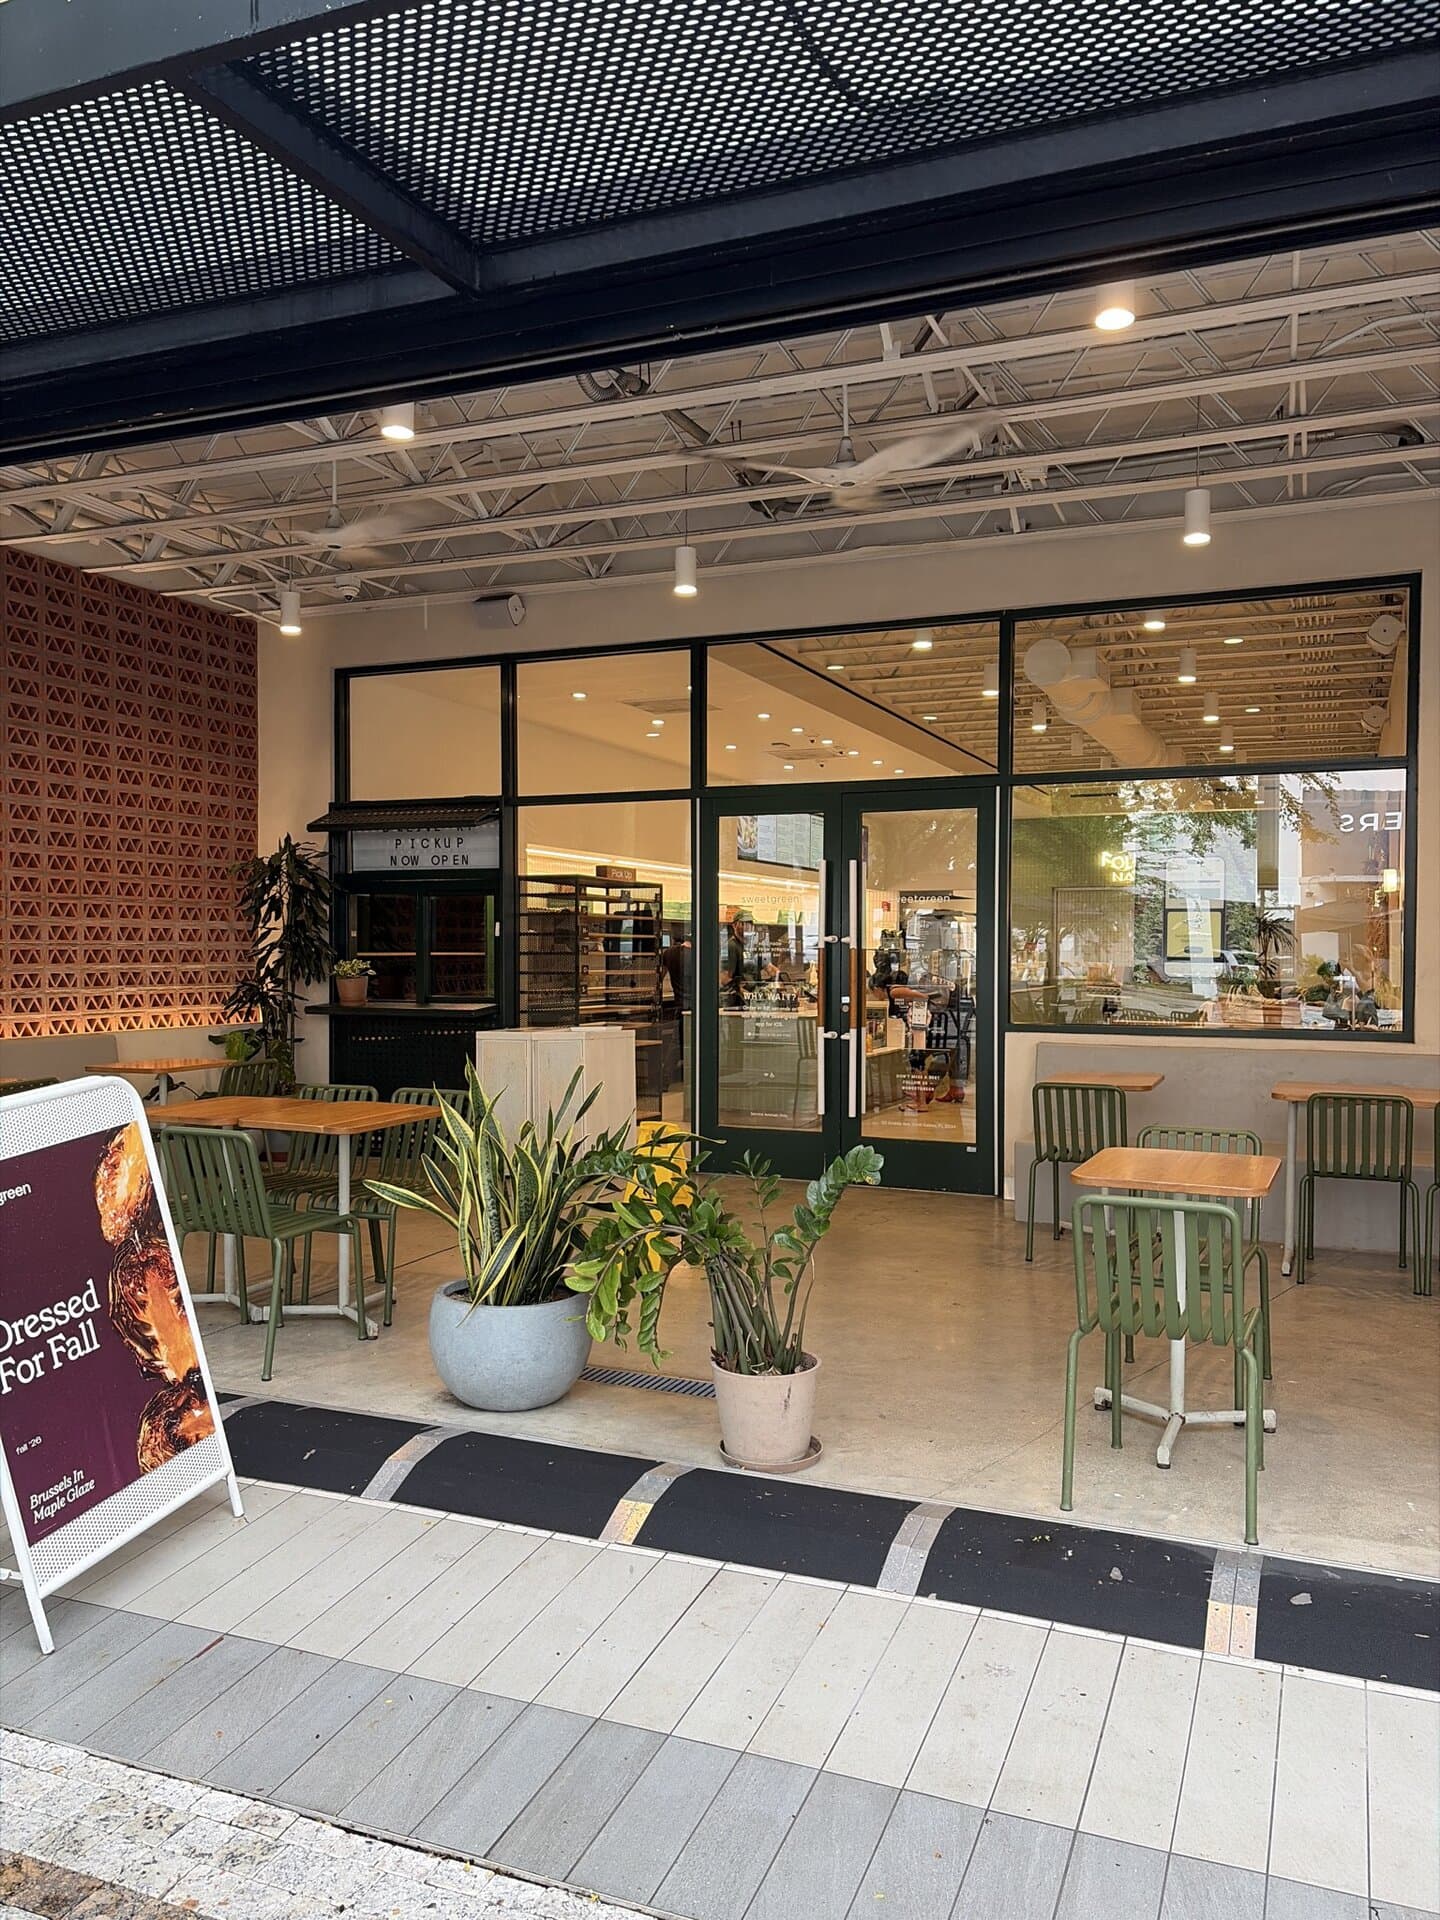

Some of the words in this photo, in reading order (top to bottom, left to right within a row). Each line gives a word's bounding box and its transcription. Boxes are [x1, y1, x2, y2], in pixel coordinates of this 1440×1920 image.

[396, 837, 464, 849] PICKUP
[390, 855, 419, 866] NOW
[431, 854, 469, 866] OPEN
[742, 894, 800, 905] sweetgreen
[743, 992, 764, 1001] WHY
[768, 992, 797, 1001] WAIT?
[0, 1277, 101, 1353] Dressed
[0, 1355, 45, 1395] For
[47, 1318, 101, 1370] Fall
[29, 1475, 73, 1510] Brussels
[72, 1469, 85, 1485] In
[32, 1495, 66, 1525] Maple
[66, 1479, 96, 1503] Glaze
